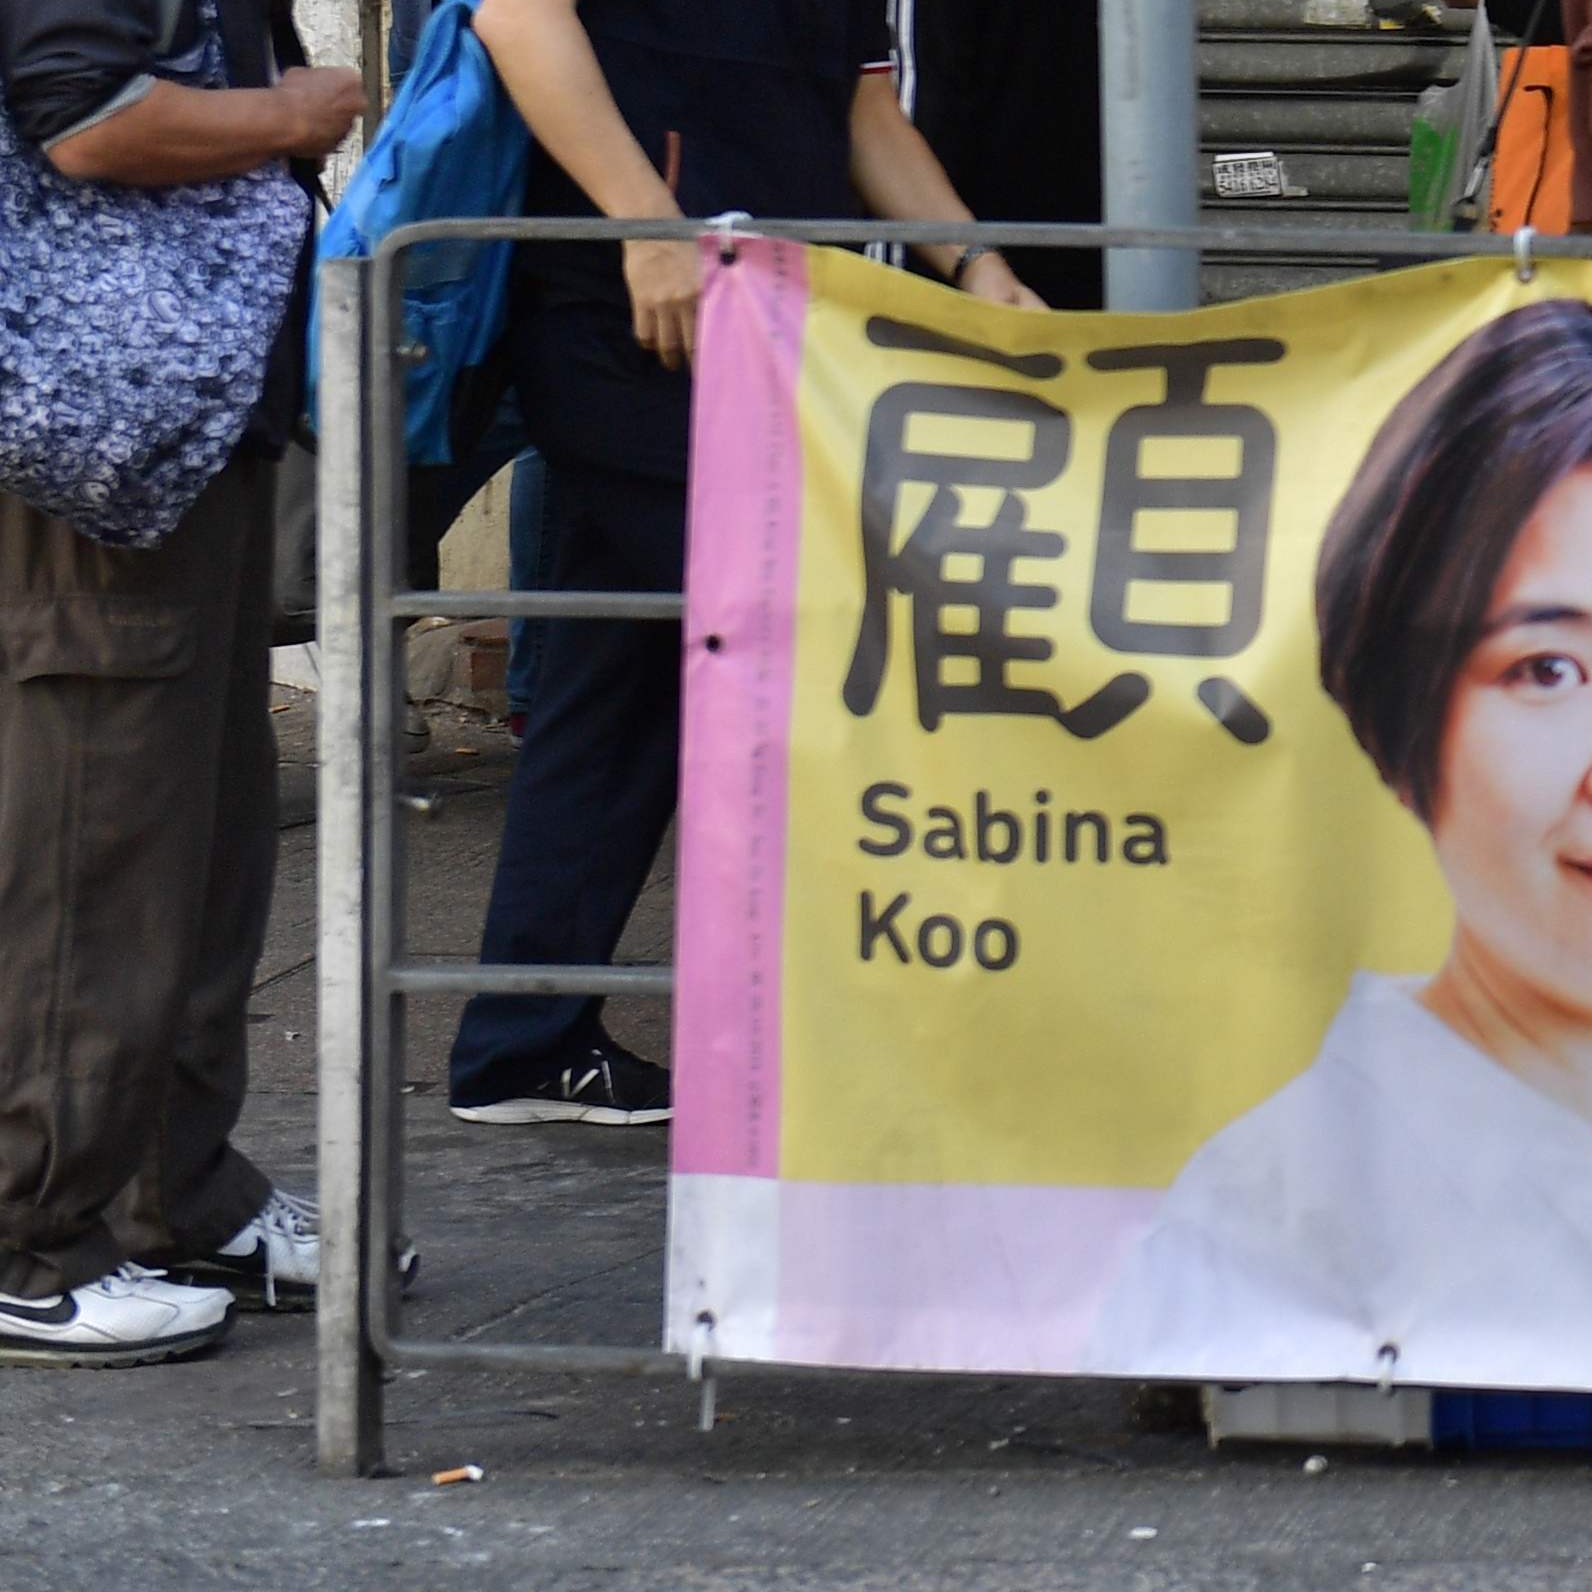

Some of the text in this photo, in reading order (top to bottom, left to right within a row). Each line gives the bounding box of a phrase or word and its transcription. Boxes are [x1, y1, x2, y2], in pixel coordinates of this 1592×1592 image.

[842, 316, 1286, 745] 顧
[858, 782, 1169, 866] Sabina
[858, 890, 1019, 972] Koo
